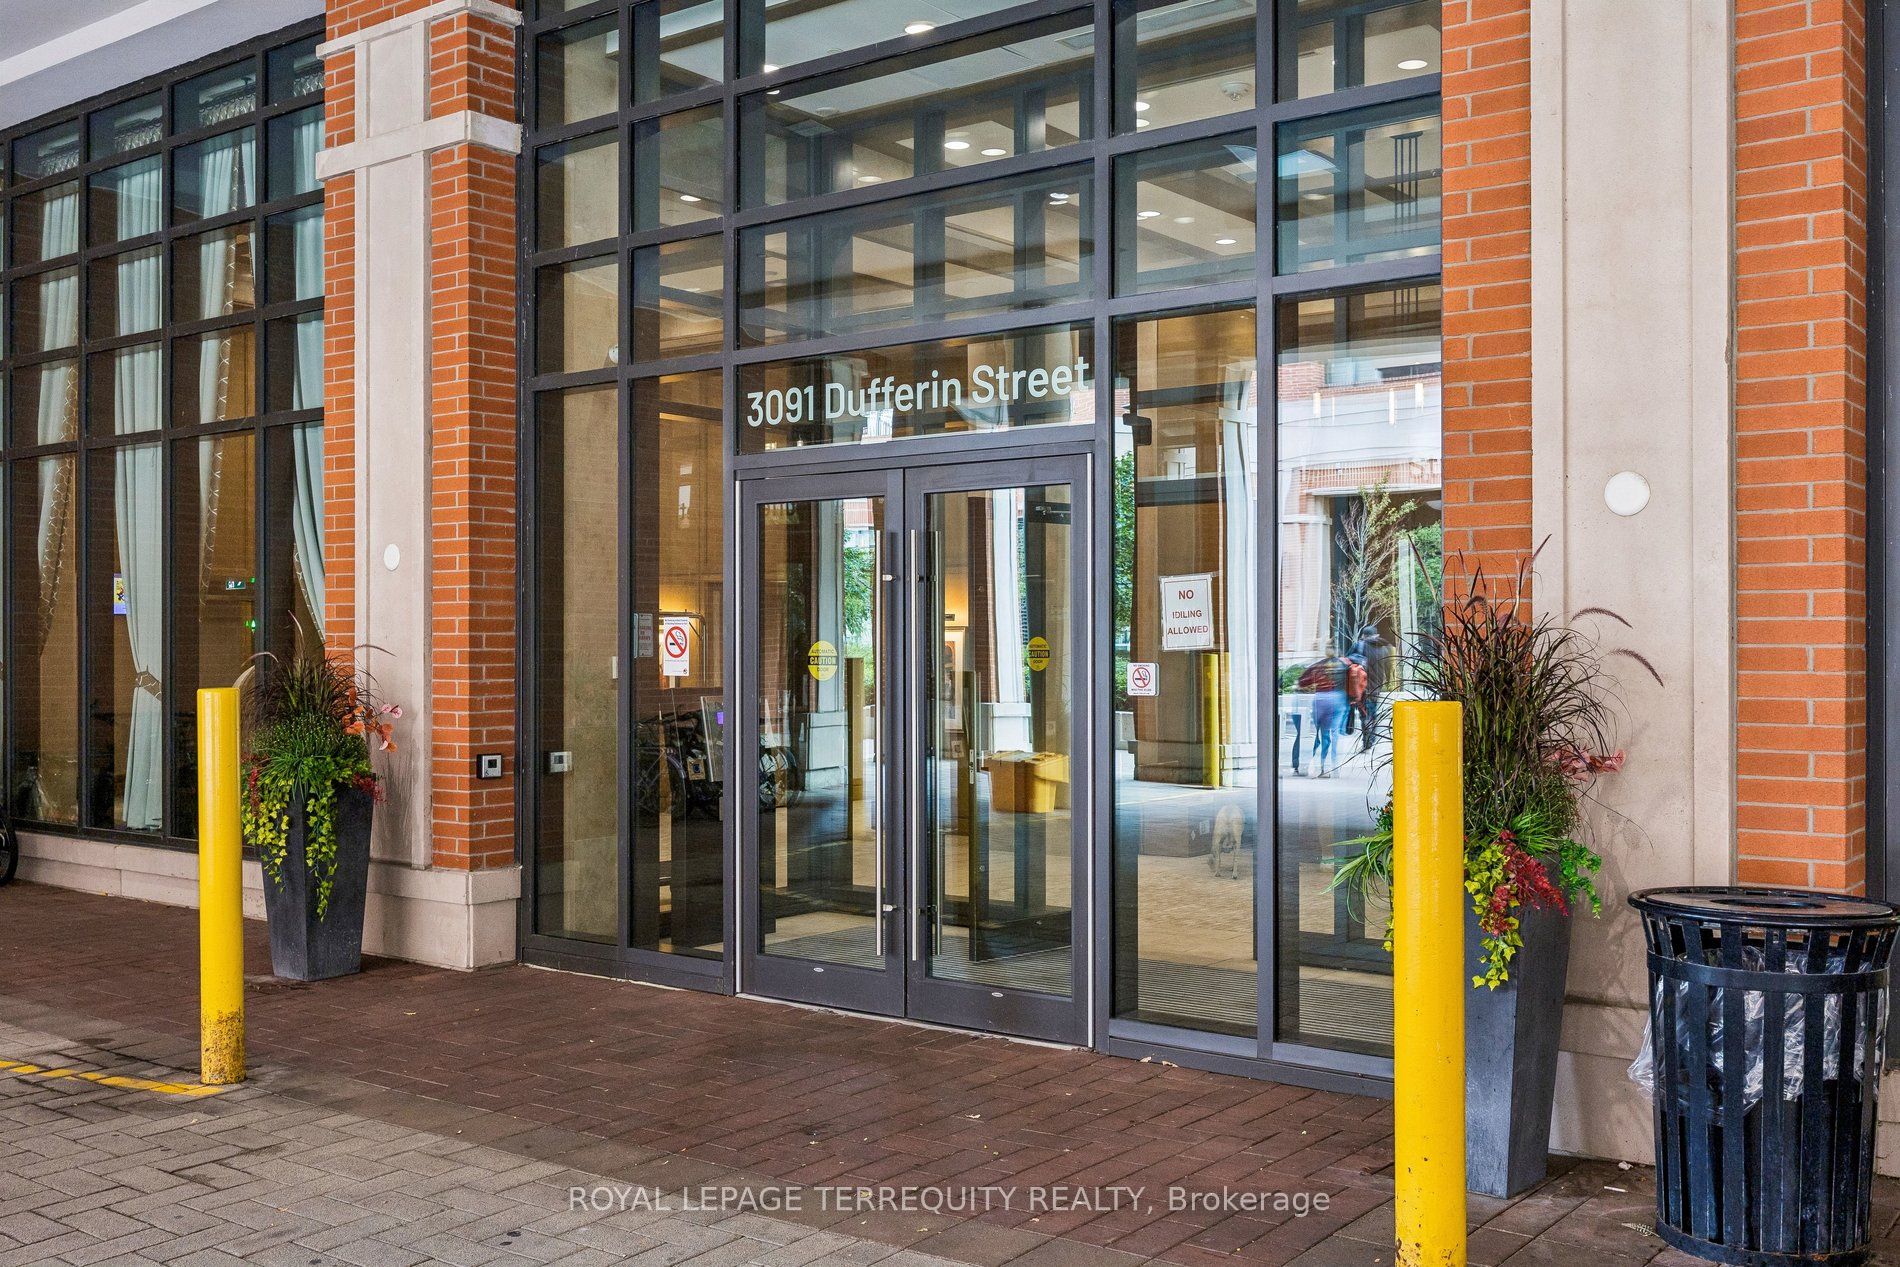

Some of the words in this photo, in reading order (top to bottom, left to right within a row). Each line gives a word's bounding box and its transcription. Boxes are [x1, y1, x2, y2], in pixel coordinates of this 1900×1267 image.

[747, 385, 814, 427] 3091
[825, 370, 961, 419] Dufferin
[972, 356, 1090, 404] Street
[1178, 589, 1194, 600] NO
[1172, 609, 1202, 619] IDILING
[1167, 625, 1209, 635] ALLOWED
[810, 656, 837, 665] CAUTION
